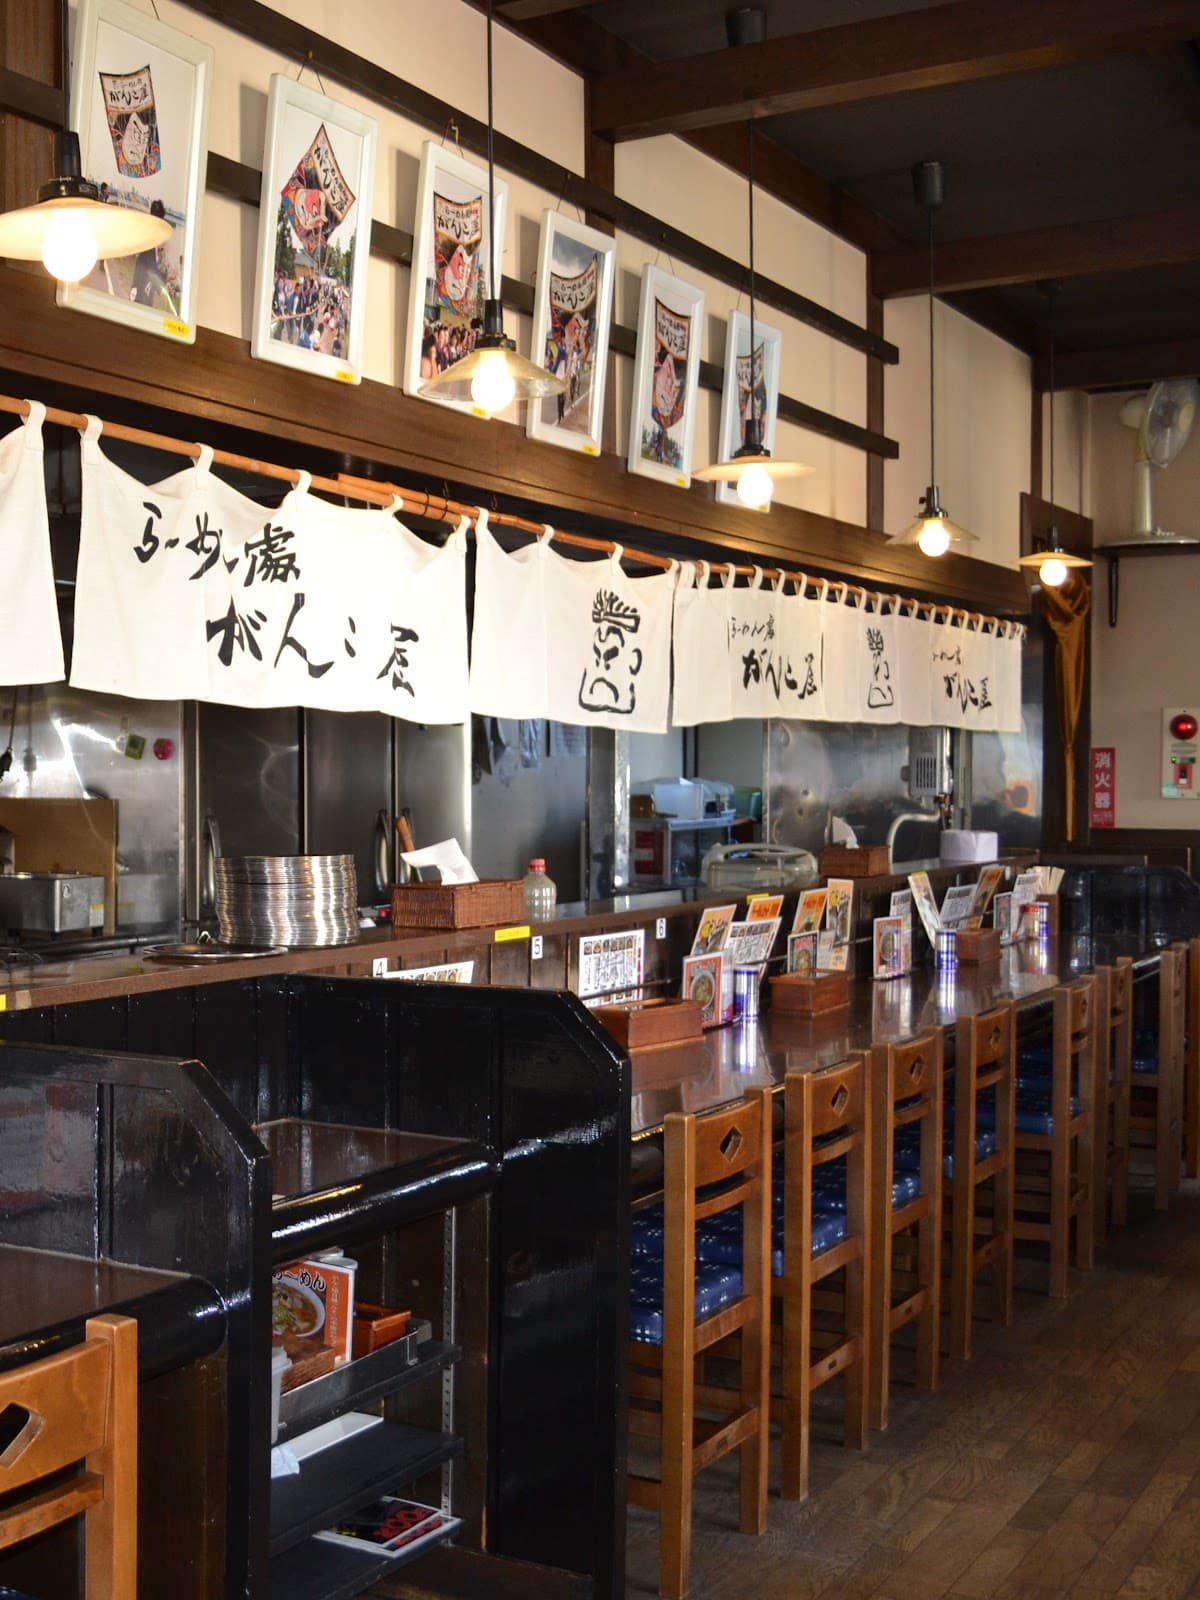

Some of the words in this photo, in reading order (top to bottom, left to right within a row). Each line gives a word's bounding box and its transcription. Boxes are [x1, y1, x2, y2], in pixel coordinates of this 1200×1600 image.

[206, 592, 420, 698] がんこ屋
[742, 647, 818, 701] がんこ屋
[1094, 751, 1111, 809] 消火器
[534, 938, 541, 955] 5
[658, 921, 665, 938] 6
